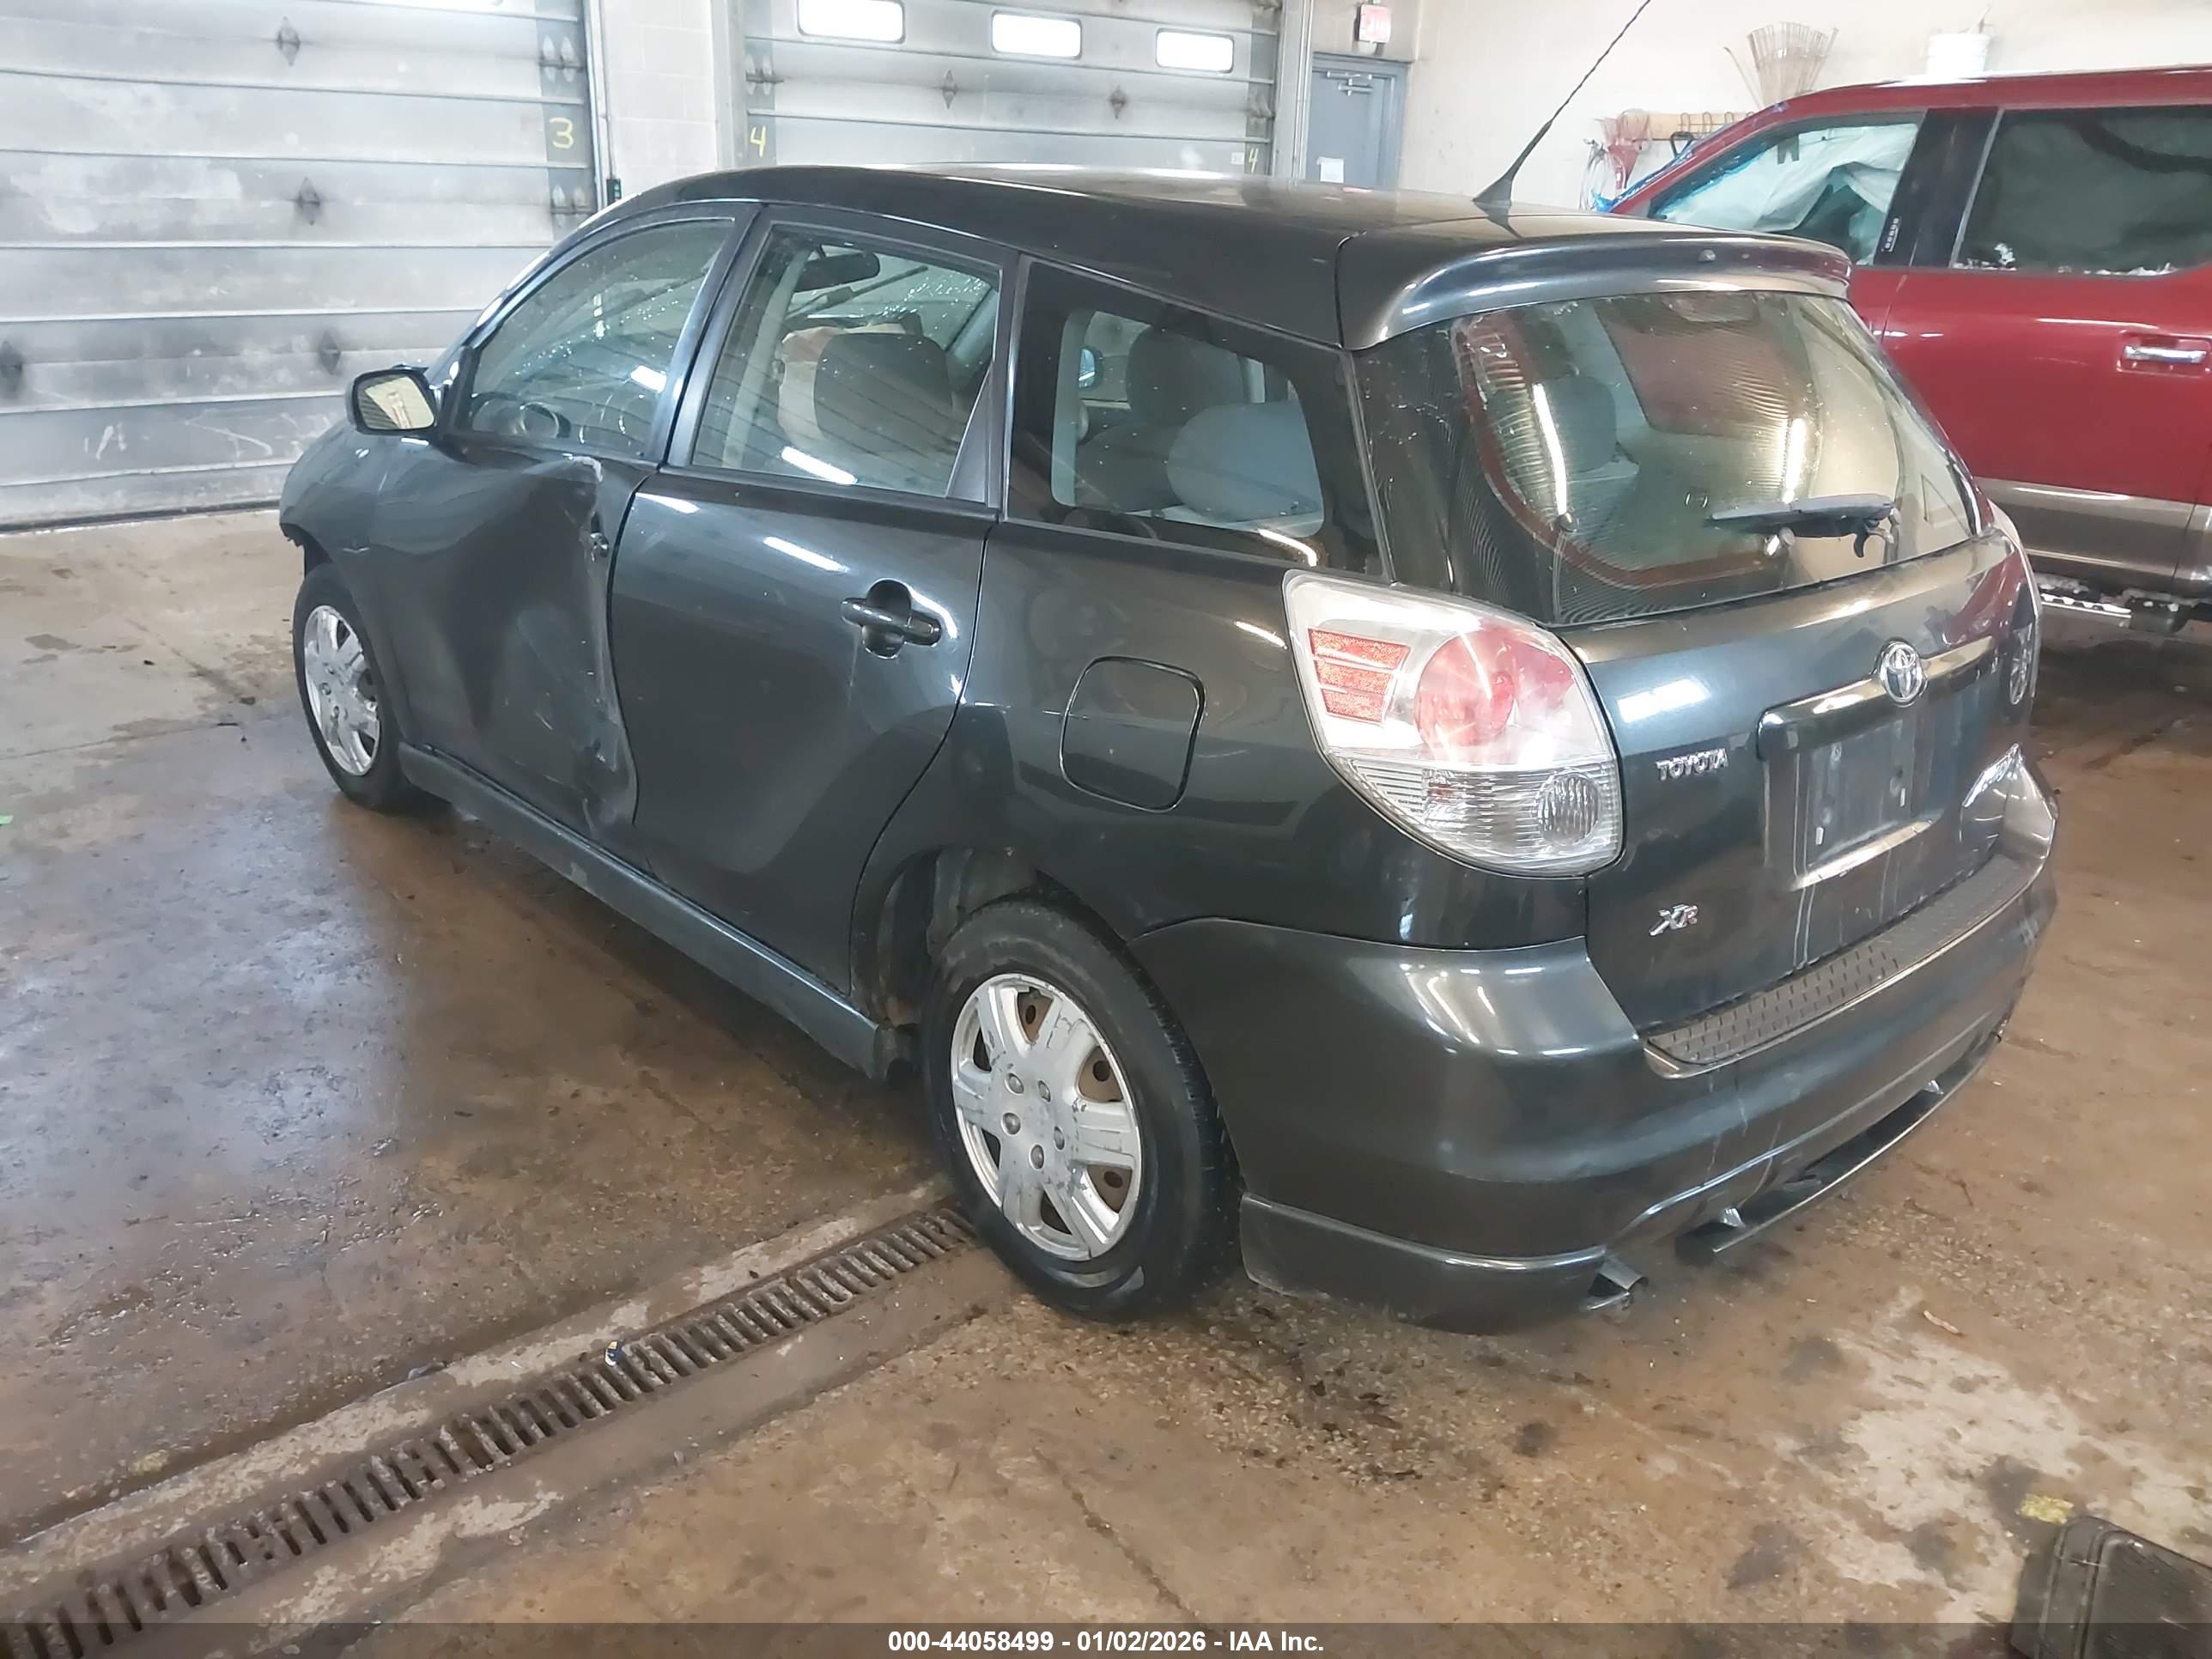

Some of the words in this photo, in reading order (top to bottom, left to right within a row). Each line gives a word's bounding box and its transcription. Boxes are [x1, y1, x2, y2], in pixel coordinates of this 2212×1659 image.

[550, 117, 574, 149] 3
[750, 125, 766, 158] 4
[1249, 148, 1259, 173] 4
[1655, 748, 1729, 781] TOYOTA
[1649, 903, 1698, 936] XR
